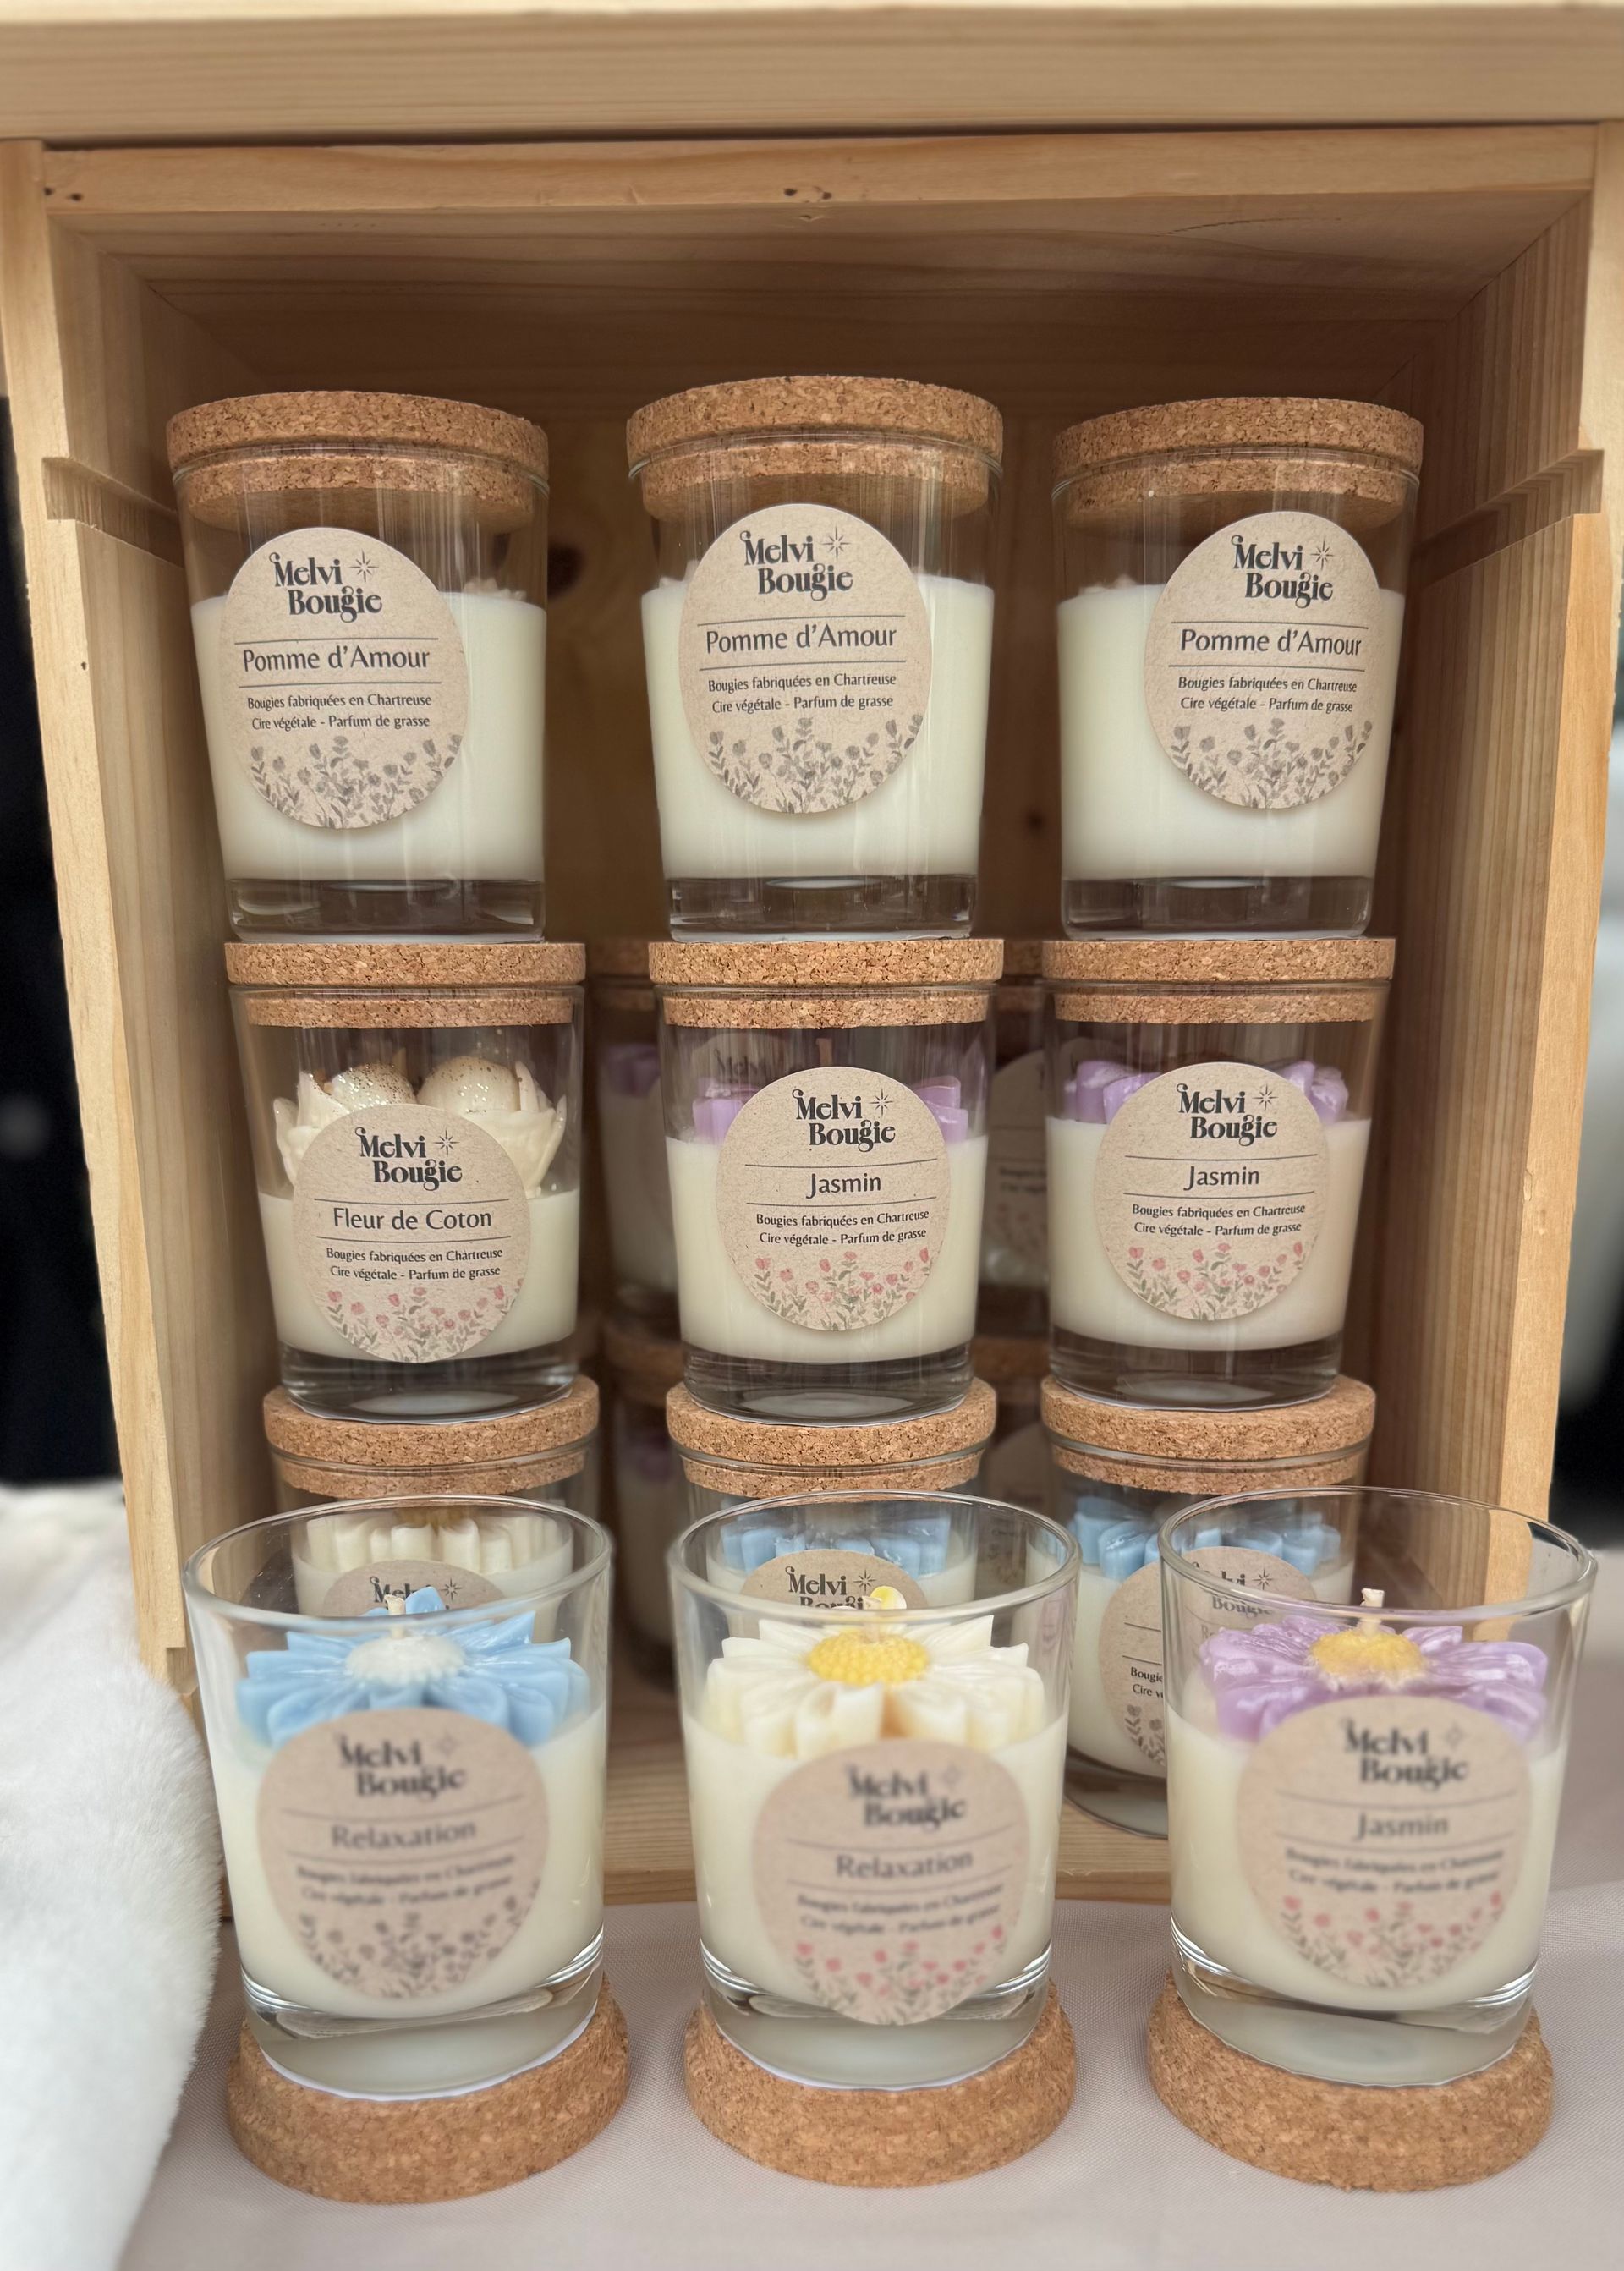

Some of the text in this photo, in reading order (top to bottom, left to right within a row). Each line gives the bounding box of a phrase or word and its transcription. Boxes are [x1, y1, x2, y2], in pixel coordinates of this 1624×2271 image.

[739, 530, 815, 566] Melvi
[1231, 535, 1303, 570] Melvi
[269, 552, 343, 587] Melvi
[758, 563, 853, 601] Bougie
[288, 585, 382, 623] Bougie
[1245, 572, 1333, 609] Bougie
[706, 623, 897, 654] Pomme d'Amour
[1180, 628, 1362, 656] Pomme d'Amour
[243, 645, 430, 672] Pomme d'Amour
[708, 673, 897, 694] Bougies fabriquées en Chartreuse
[1178, 677, 1358, 693] Bougies fabriquées en Chartreuse
[247, 694, 432, 711] Bougies fabriquées en Chartreuse
[712, 701, 732, 713] Cire
[736, 698, 782, 714] végétale
[793, 696, 837, 710] Parfum
[840, 695, 855, 708] de
[859, 697, 893, 710] grasse
[1180, 697, 1204, 710] Cire
[1208, 696, 1257, 711] végétale
[1269, 698, 1309, 710] Parfum
[1311, 699, 1324, 711] de
[1325, 702, 1352, 713] grasse
[252, 717, 271, 730] Cire
[273, 716, 316, 732] végétale
[328, 715, 371, 728] Parfum
[375, 715, 390, 727] de
[393, 716, 430, 730] grasse
[792, 1089, 863, 1120] Melvi
[1176, 1083, 1246, 1114] Melvi
[354, 1127, 426, 1158] Melvi
[809, 1120, 896, 1153] Bougie
[1190, 1114, 1278, 1147] Bougie
[373, 1159, 463, 1192] Bougie
[805, 1173, 881, 1199] Jasmin
[1183, 1166, 1259, 1191] Jasmin
[333, 1208, 492, 1230] Fleur de Coton
[756, 1210, 930, 1228] Bougies fabriquées en Chartreuse
[1132, 1204, 1306, 1220] Bougies fabriquées en Chartreuse
[759, 1232, 781, 1244] Cire
[784, 1232, 829, 1248] végétale
[840, 1233, 880, 1244] Parfum
[882, 1231, 895, 1242] de
[897, 1229, 927, 1242] grasse
[1134, 1222, 1155, 1234] Cire
[1159, 1224, 1204, 1237] végétale
[1215, 1225, 1254, 1236] Parfum
[1257, 1223, 1270, 1234] de
[1272, 1222, 1302, 1236] grasse
[326, 1248, 503, 1264] Bougies fabriquées en Chartreuse
[330, 1265, 351, 1277] Cire
[354, 1268, 398, 1281] végétale
[409, 1270, 449, 1280] Parfum
[453, 1268, 466, 1279] de
[469, 1266, 501, 1281] grasse
[785, 1566, 847, 1595] Melvi
[1132, 1683, 1153, 1697] Cire
[331, 1821, 476, 1849] Relaxation
[1354, 1813, 1448, 1842] Jasmin
[836, 1851, 973, 1879] Relaxation
